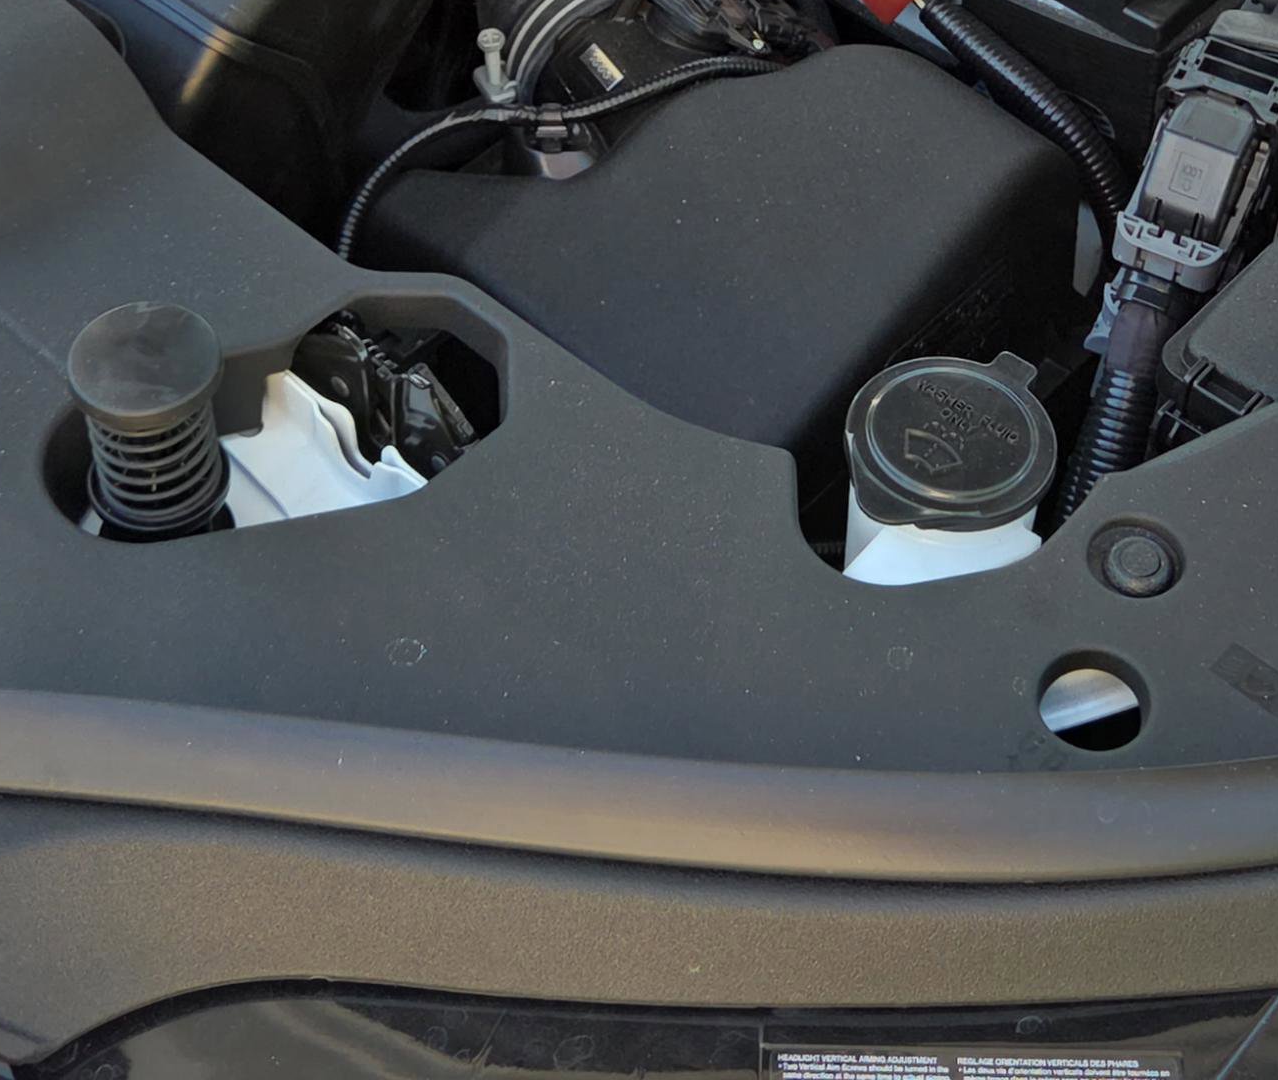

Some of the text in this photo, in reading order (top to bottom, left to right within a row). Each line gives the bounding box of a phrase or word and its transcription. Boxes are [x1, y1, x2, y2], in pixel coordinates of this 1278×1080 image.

[916, 379, 1019, 445] WASHER FLUID
[940, 407, 978, 431] ONLY
[821, 1054, 857, 1063] VERTICAL
